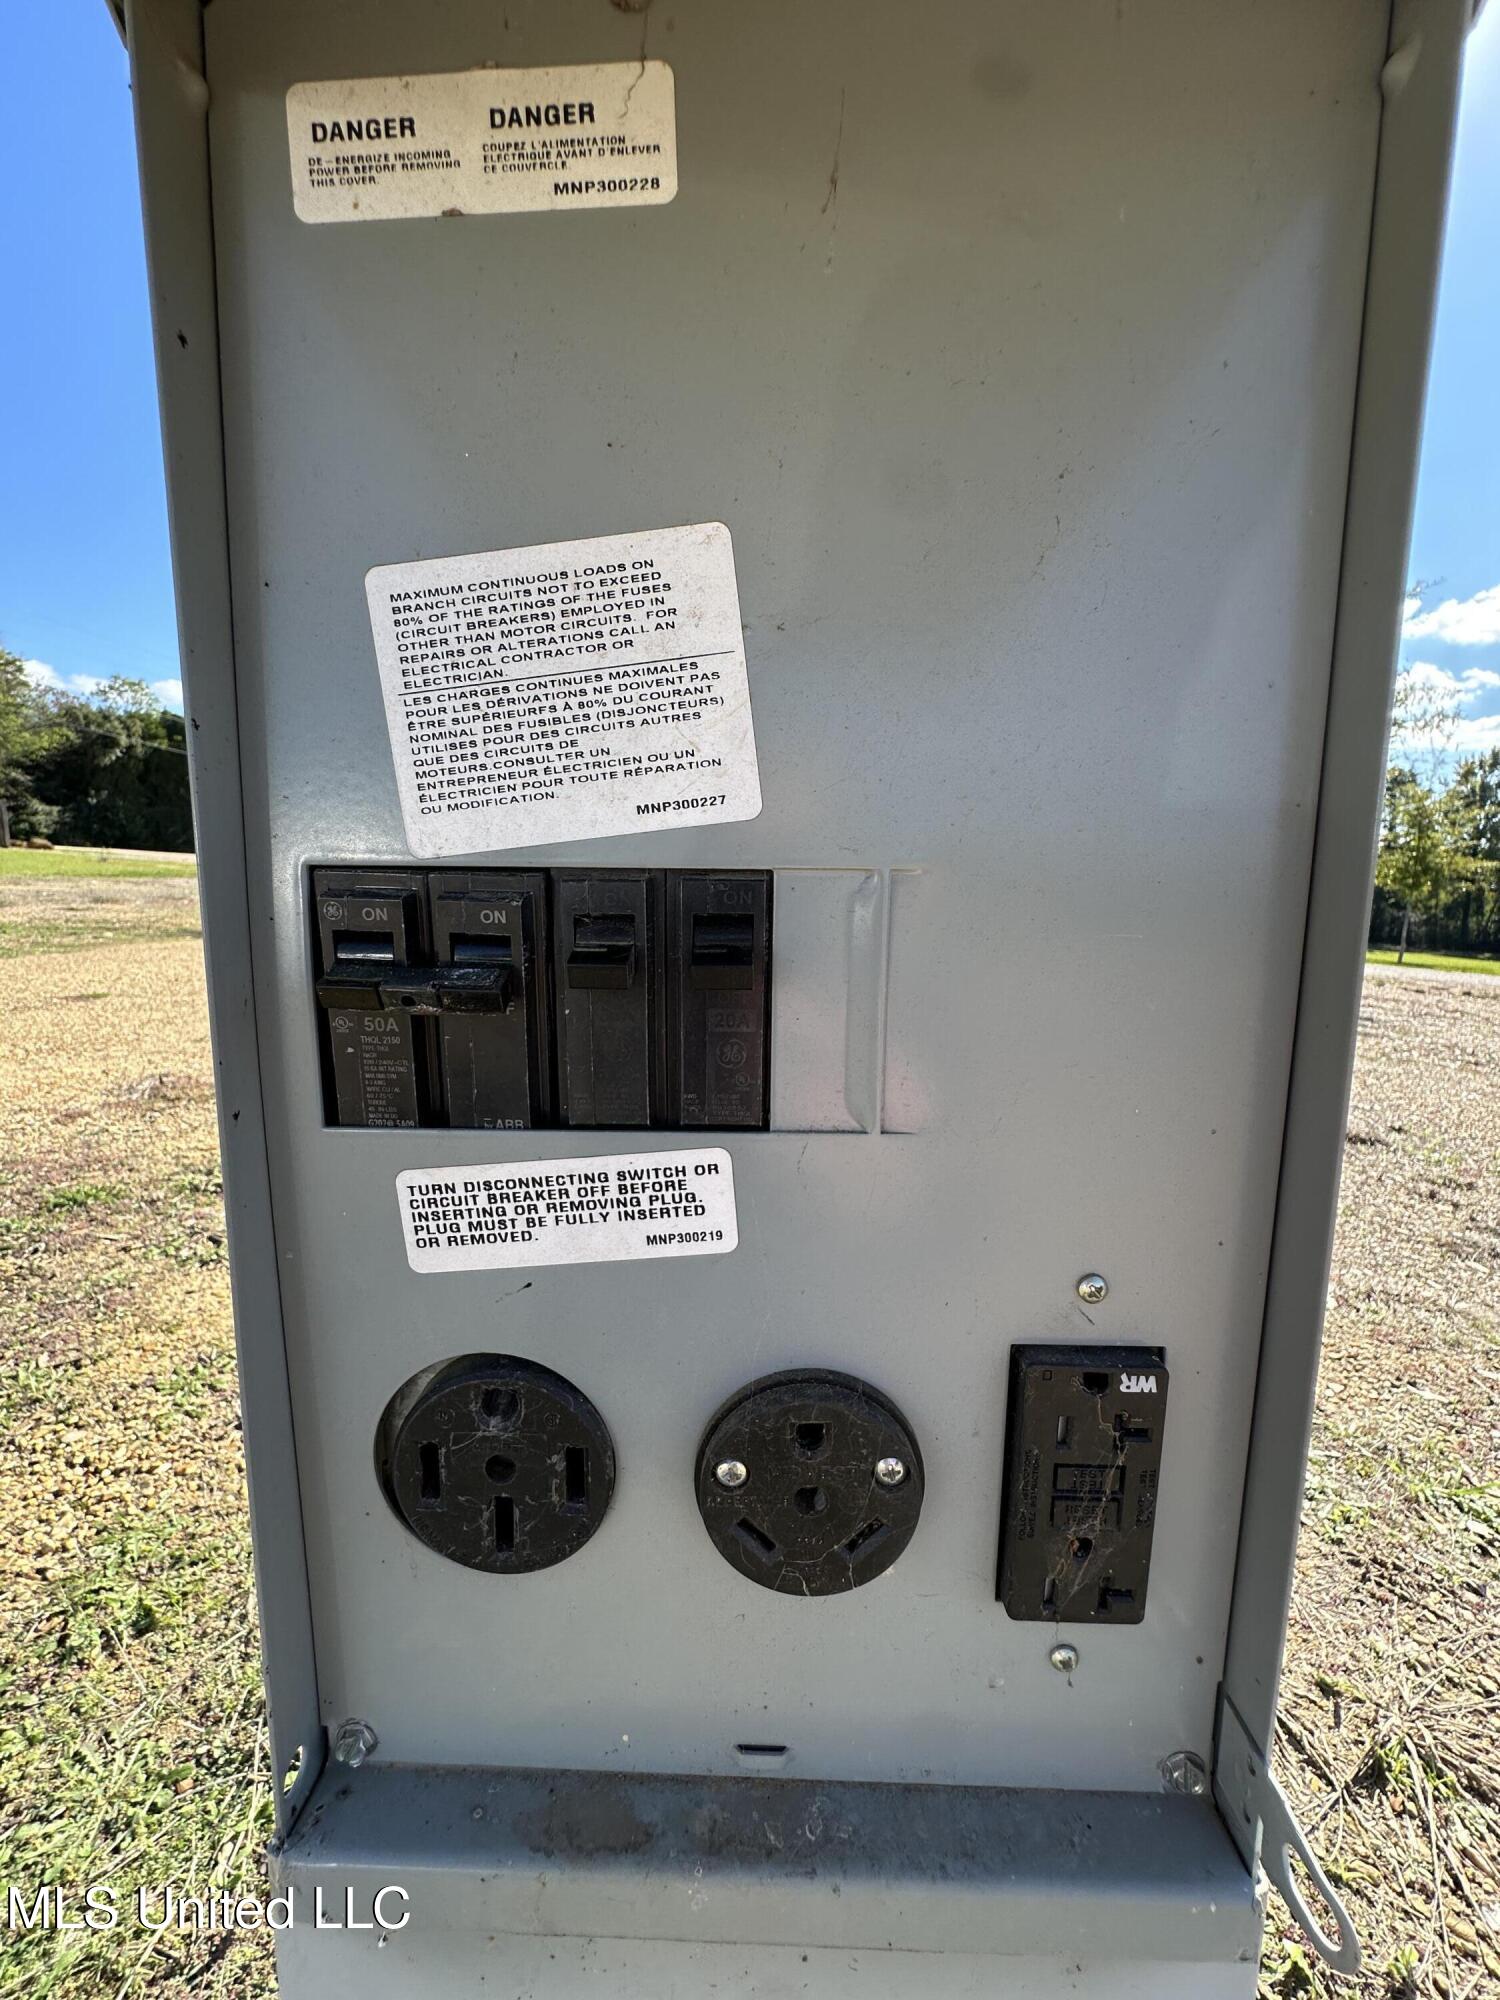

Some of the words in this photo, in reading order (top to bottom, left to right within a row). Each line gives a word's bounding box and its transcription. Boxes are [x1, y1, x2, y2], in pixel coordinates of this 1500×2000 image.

[311, 116, 416, 144] DANGER
[489, 102, 595, 130] DANGER
[394, 148, 451, 162] INCOMING
[482, 141, 526, 155] COUPEZ
[556, 148, 592, 160] AVANT
[308, 165, 350, 178] POWER
[353, 163, 396, 175] BEFORE
[401, 158, 461, 172] REMOVING
[483, 164, 497, 174] CE
[310, 178, 336, 188] THIS
[554, 177, 660, 196] MNP300228
[389, 584, 464, 603] MAXIMUM
[467, 570, 569, 593] CONTINUOUS
[573, 562, 627, 578] LOADS
[631, 558, 654, 570] ON
[391, 598, 456, 616] BRANCH
[460, 588, 532, 606] CIRCUITS
[537, 583, 569, 596] NOT
[572, 580, 595, 593] TO
[599, 571, 662, 588] EXCEED
[393, 616, 424, 628] 80%
[428, 612, 449, 623] OF
[453, 607, 484, 620] THE
[488, 598, 556, 616] RATINGS
[560, 594, 584, 606] OF
[585, 590, 616, 602] THE
[620, 582, 672, 598] FUSES
[395, 623, 462, 642] (CIRCUIT
[466, 610, 556, 631] BREAKERS)
[560, 599, 645, 619] EMPLOYED
[650, 596, 665, 607] IN
[397, 638, 450, 652] OTHER
[454, 630, 496, 645] THAN
[500, 623, 556, 640] MOTOR
[560, 613, 636, 631] CIRCUITS.
[646, 607, 678, 620] FOR
[399, 648, 466, 665] REPAIRS
[470, 644, 493, 656] OR
[497, 630, 604, 653] ALTERATIONS
[608, 624, 650, 638] CALL
[654, 620, 676, 632] AN
[401, 657, 497, 678] ELECTRICAL
[500, 642, 608, 665] CONTRACTOR
[612, 639, 634, 650] OR
[403, 668, 509, 690] ELECTRICIAN.
[403, 696, 432, 708] LES
[436, 685, 511, 703] CHARGES
[515, 673, 604, 693] CONTINUES
[608, 661, 699, 681] MAXIMALES
[405, 706, 449, 720] POUR
[452, 701, 484, 714] LES
[485, 688, 588, 709] DÉRIVATIONS
[592, 684, 614, 696] NE
[618, 675, 686, 692] DOIVENT
[689, 671, 721, 683] PAS
[562, 701, 574, 712] À
[577, 698, 608, 710] 80%
[612, 694, 634, 706] DU
[635, 684, 714, 704] COURANT
[409, 727, 479, 744] NOMINAL
[482, 722, 513, 735] DES
[517, 712, 592, 730] FUSIBLES
[596, 696, 724, 722] (DISJONCTEURS)
[411, 739, 478, 756] UTILISES
[482, 733, 526, 748] POUR
[529, 729, 560, 741] DES
[564, 719, 636, 736] CIRCUITS
[640, 710, 702, 728] AUTRES
[413, 756, 445, 768] QUE
[449, 751, 480, 764] DES
[482, 742, 554, 759] CIRCUITS
[558, 738, 580, 750] DE
[589, 746, 611, 758] UN
[416, 768, 539, 792] ENTREPRENEUR
[543, 755, 642, 776] ÉLECTRICIEN
[647, 752, 672, 763] OU
[673, 746, 700, 760] UN
[418, 783, 518, 804] ÉLECTRICIEN
[521, 777, 564, 791] POUR
[568, 770, 619, 785] TOUTE
[623, 758, 722, 778] RÉPARATION
[420, 804, 442, 815] OU
[446, 790, 560, 812] MODIFICATION.
[636, 794, 726, 816] MNP300227
[362, 907, 388, 921] ON
[480, 910, 507, 924] ON
[364, 1017, 399, 1032] 50A
[406, 1182, 456, 1197] TURN
[463, 1172, 610, 1194] DISCONNECTING
[616, 1165, 687, 1182] SWITCH
[694, 1163, 720, 1176] OR
[409, 1194, 480, 1210] CIRCUIT
[486, 1188, 571, 1205] BREAKER
[577, 1184, 611, 1198] OFF
[617, 1178, 688, 1196] BEFORE
[411, 1205, 507, 1223] INSERTING
[514, 1203, 539, 1216] OR
[546, 1196, 642, 1214] REMOVING
[648, 1192, 703, 1207] PLUG.
[413, 1222, 461, 1236] PLUG
[467, 1218, 518, 1233] MUST
[525, 1216, 548, 1229] BE
[554, 1211, 610, 1226] FULLY
[617, 1204, 706, 1222] INSERTED
[415, 1236, 440, 1249] OR
[446, 1230, 539, 1247] REMOVED.
[646, 1230, 723, 1246] MNP300219
[1120, 1372, 1157, 1393] WR
